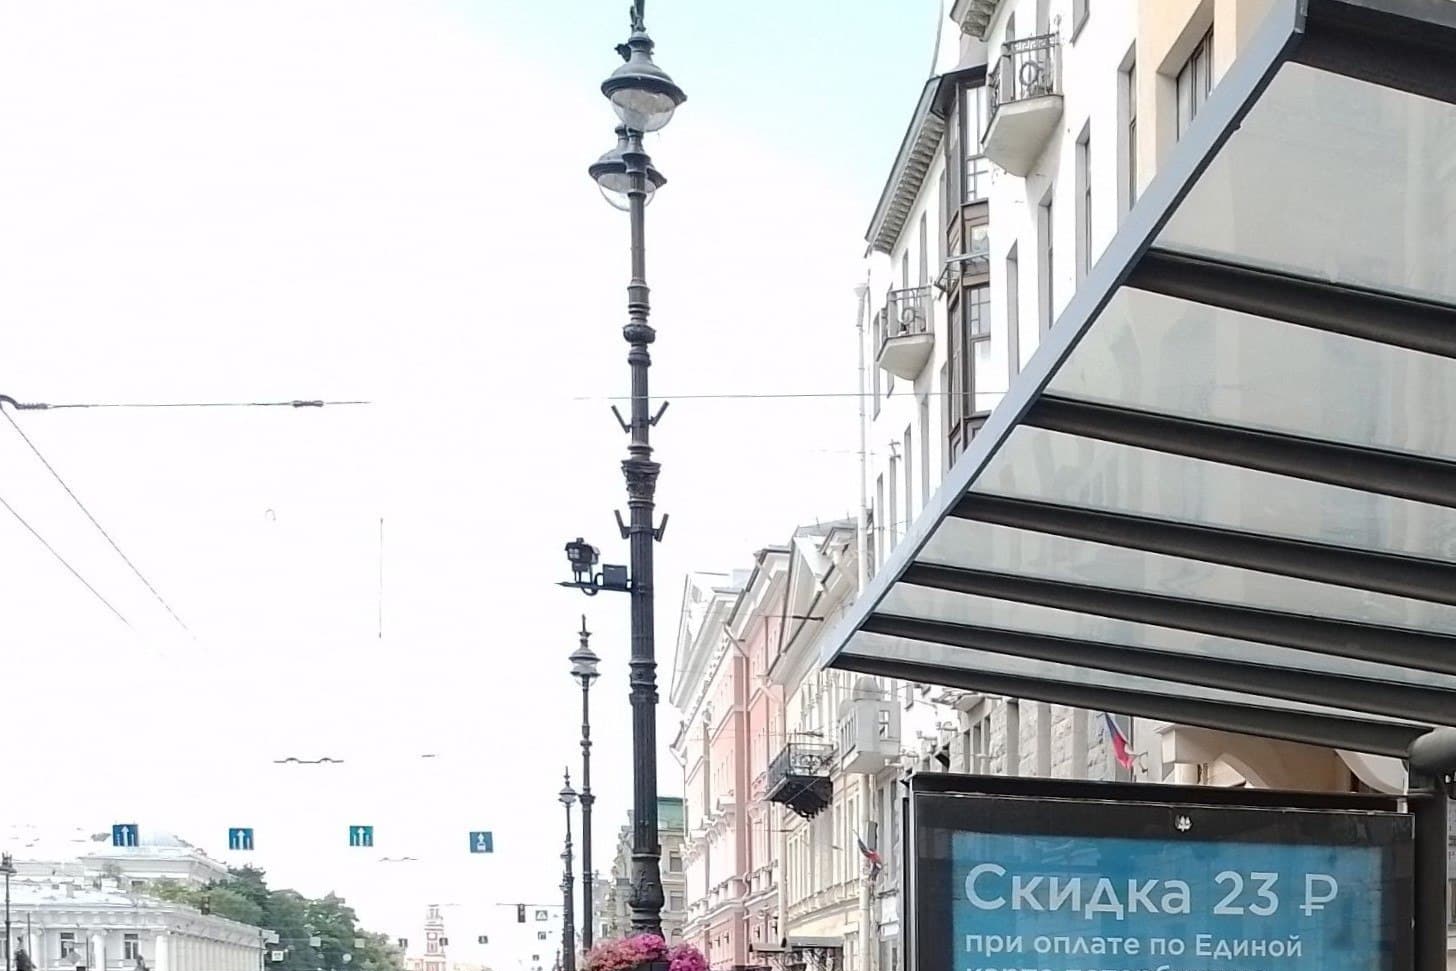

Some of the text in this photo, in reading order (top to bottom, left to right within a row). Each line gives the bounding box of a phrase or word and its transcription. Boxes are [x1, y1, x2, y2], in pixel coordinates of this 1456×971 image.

[965, 863, 1191, 920] Скидка
[1213, 870, 1279, 916] 23
[966, 933, 1302, 960] при оплате по Единой
